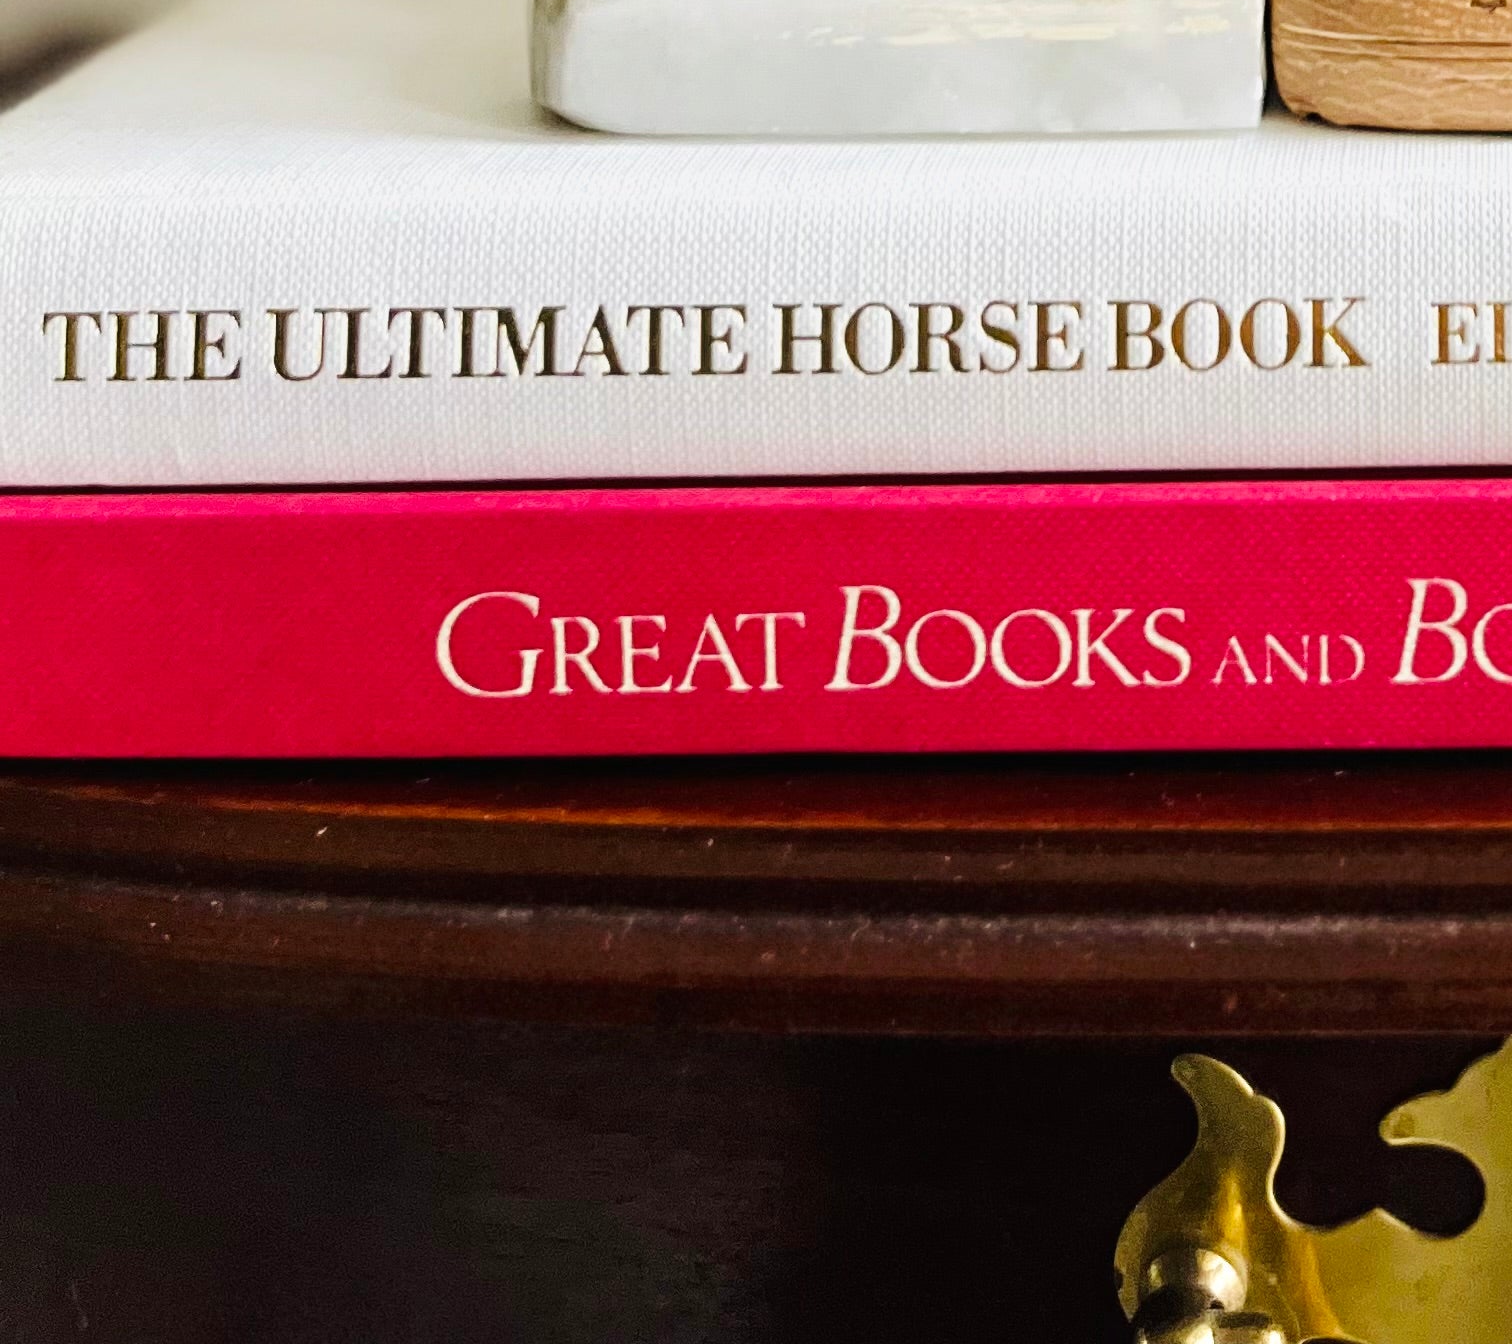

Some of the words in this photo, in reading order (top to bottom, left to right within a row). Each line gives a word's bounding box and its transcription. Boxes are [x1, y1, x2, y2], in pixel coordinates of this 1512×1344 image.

[43, 311, 240, 381] THE
[267, 306, 745, 381] ULTIMATE
[774, 302, 1083, 373] HORSE
[1108, 300, 1370, 371] BOOK
[437, 592, 804, 696] GREAT
[826, 586, 1190, 689] BOOKS
[1214, 635, 1366, 683] AND
